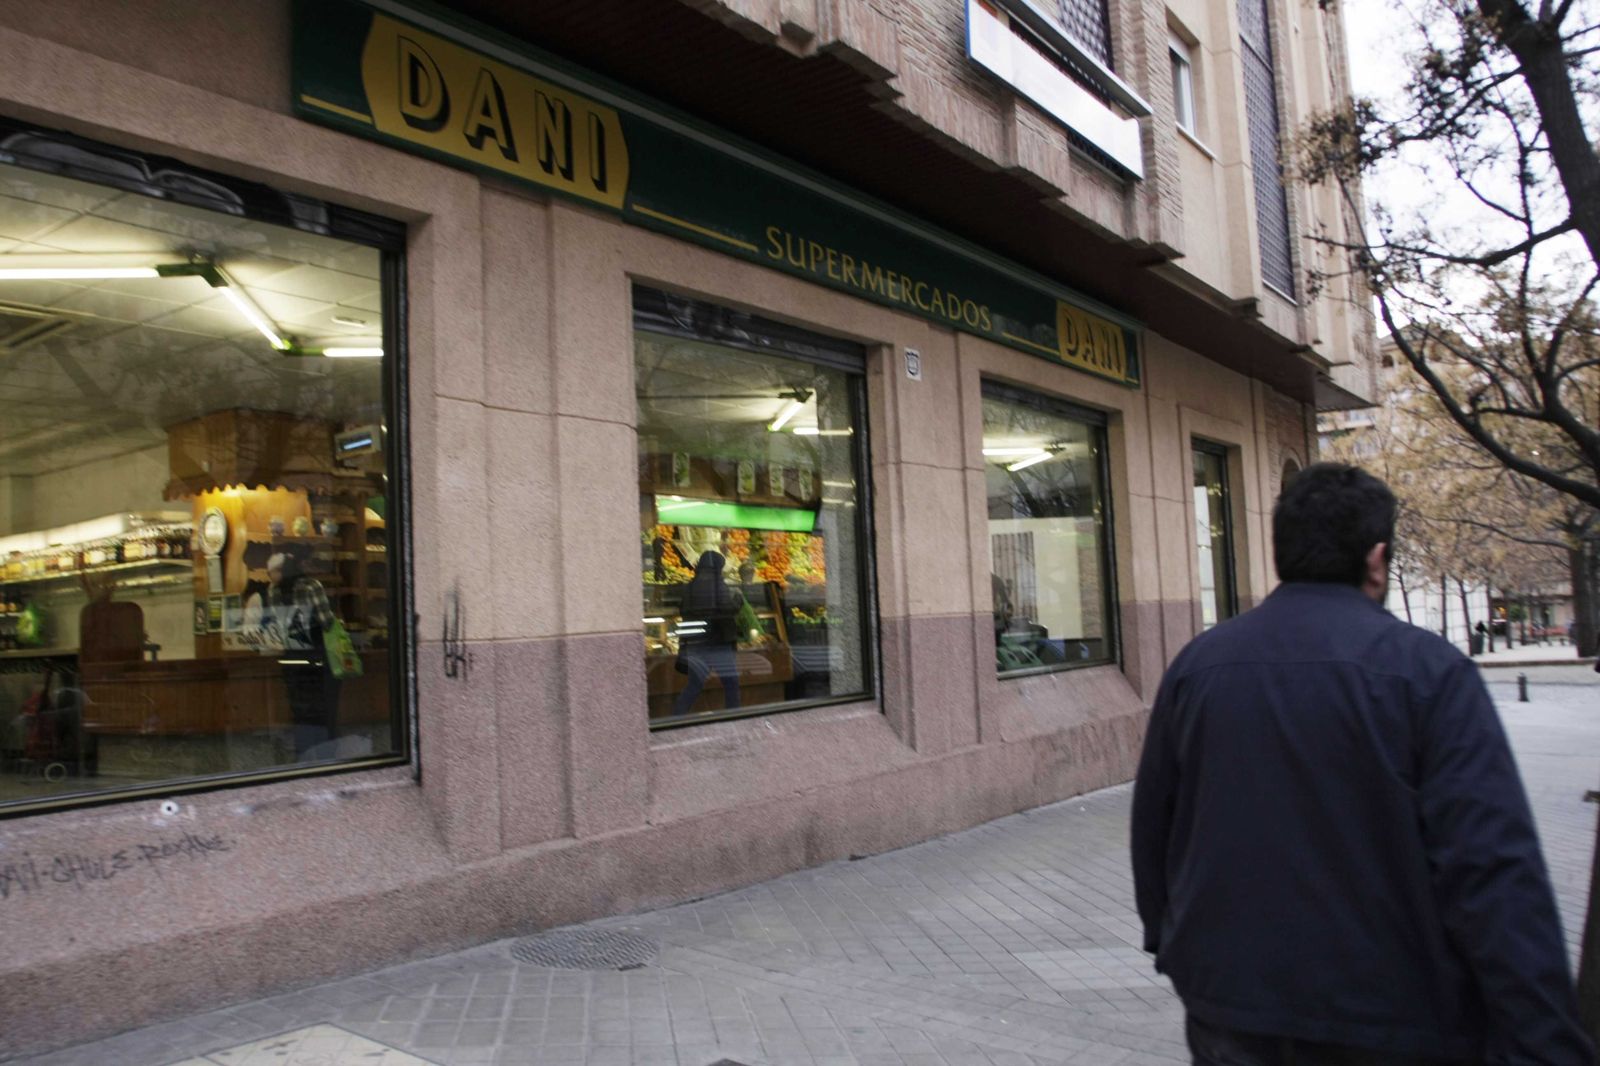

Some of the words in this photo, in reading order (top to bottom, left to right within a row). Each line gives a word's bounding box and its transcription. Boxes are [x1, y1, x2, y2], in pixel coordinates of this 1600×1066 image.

[397, 33, 608, 194] DANI
[766, 226, 993, 332] SUPERMERCADOS
[1062, 306, 1122, 374] DANI
